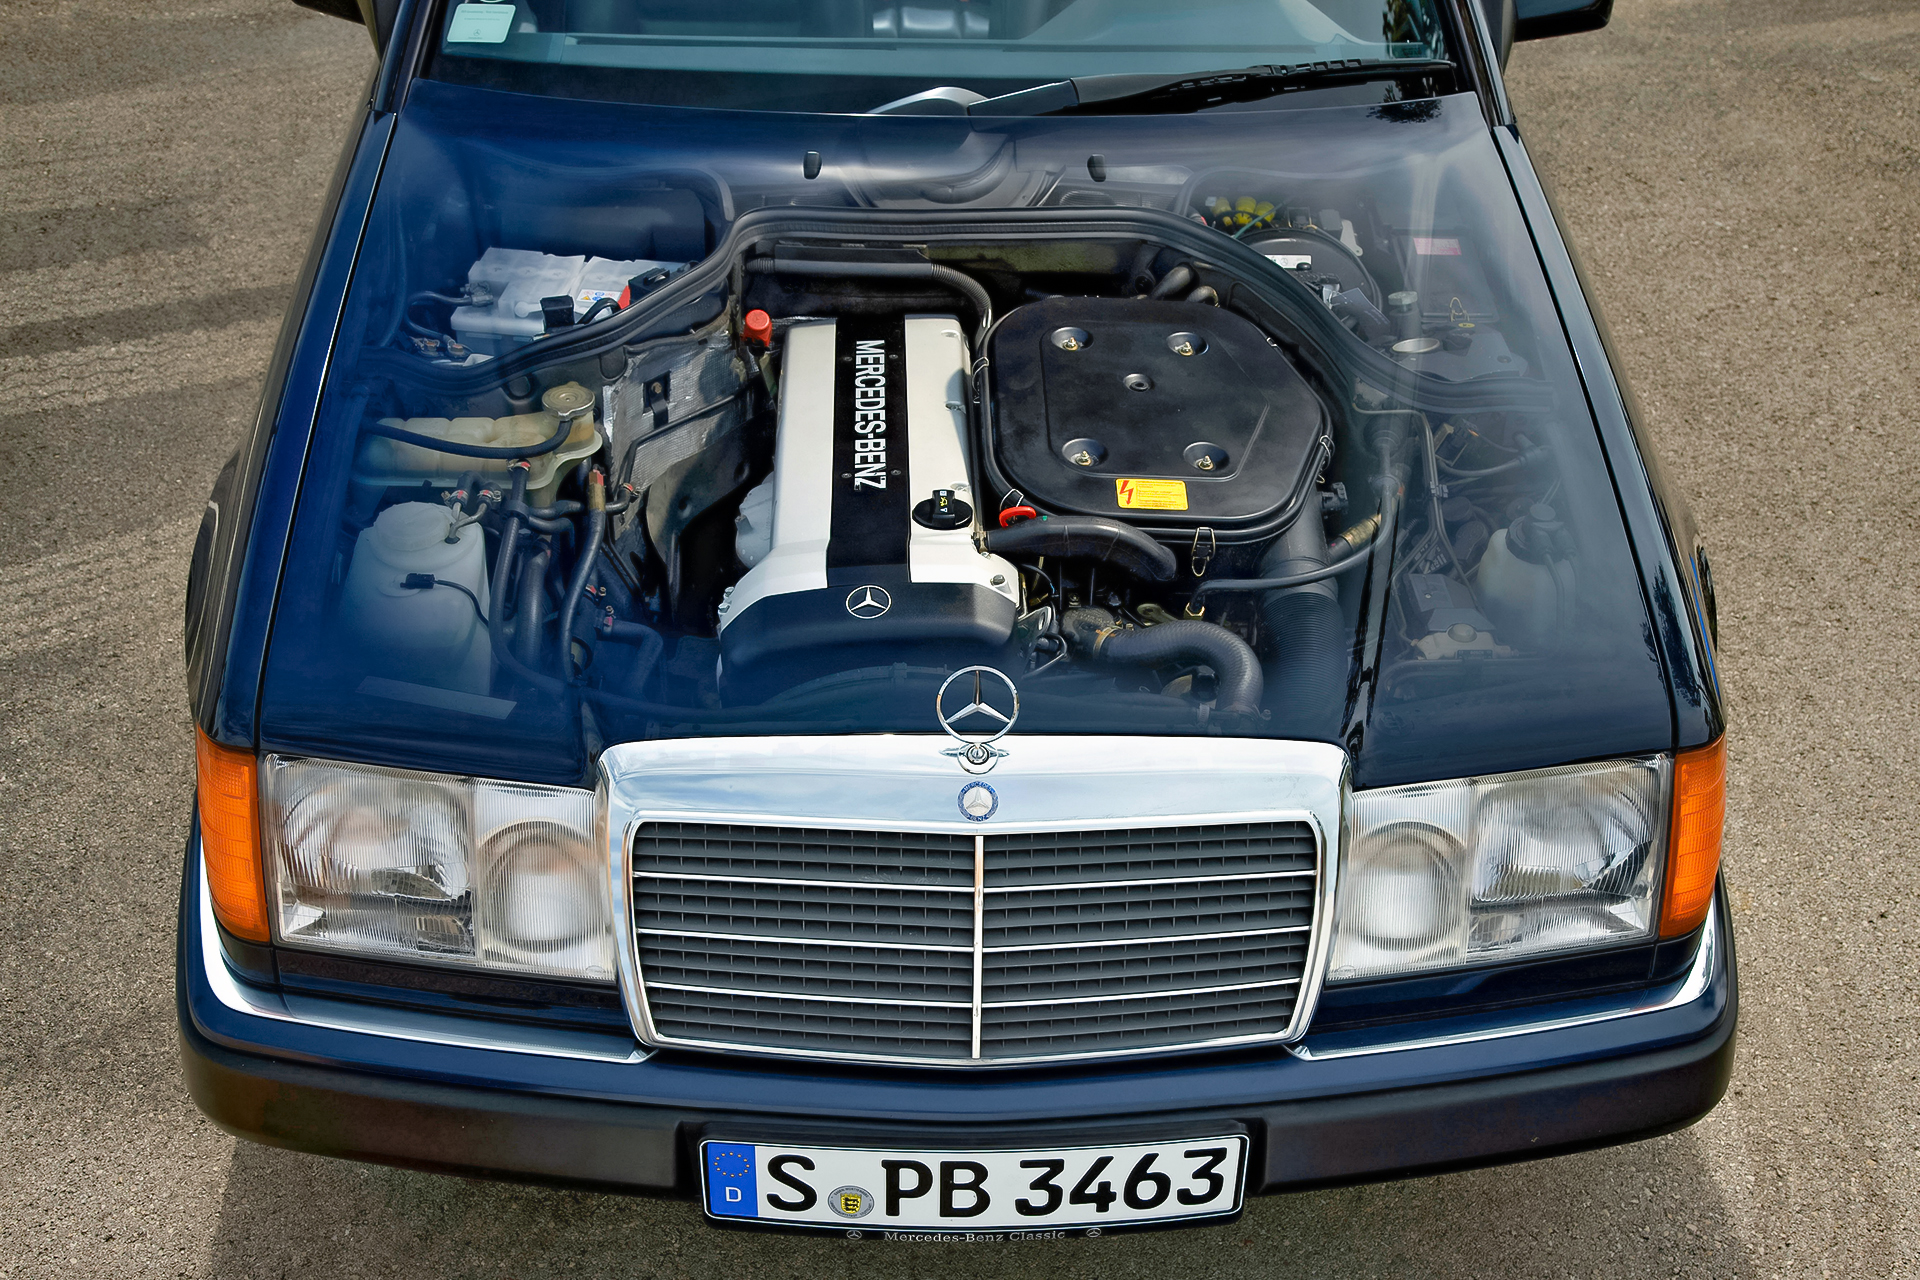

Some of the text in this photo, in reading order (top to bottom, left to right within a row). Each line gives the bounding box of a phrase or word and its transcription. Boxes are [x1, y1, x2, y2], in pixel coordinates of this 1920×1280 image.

[855, 339, 887, 489] MERCEDES-BENZ
[725, 1186, 742, 1203] D
[766, 1147, 1228, 1218] S PB 3463
[883, 1230, 1066, 1243] Mercedes-Benz Classic
